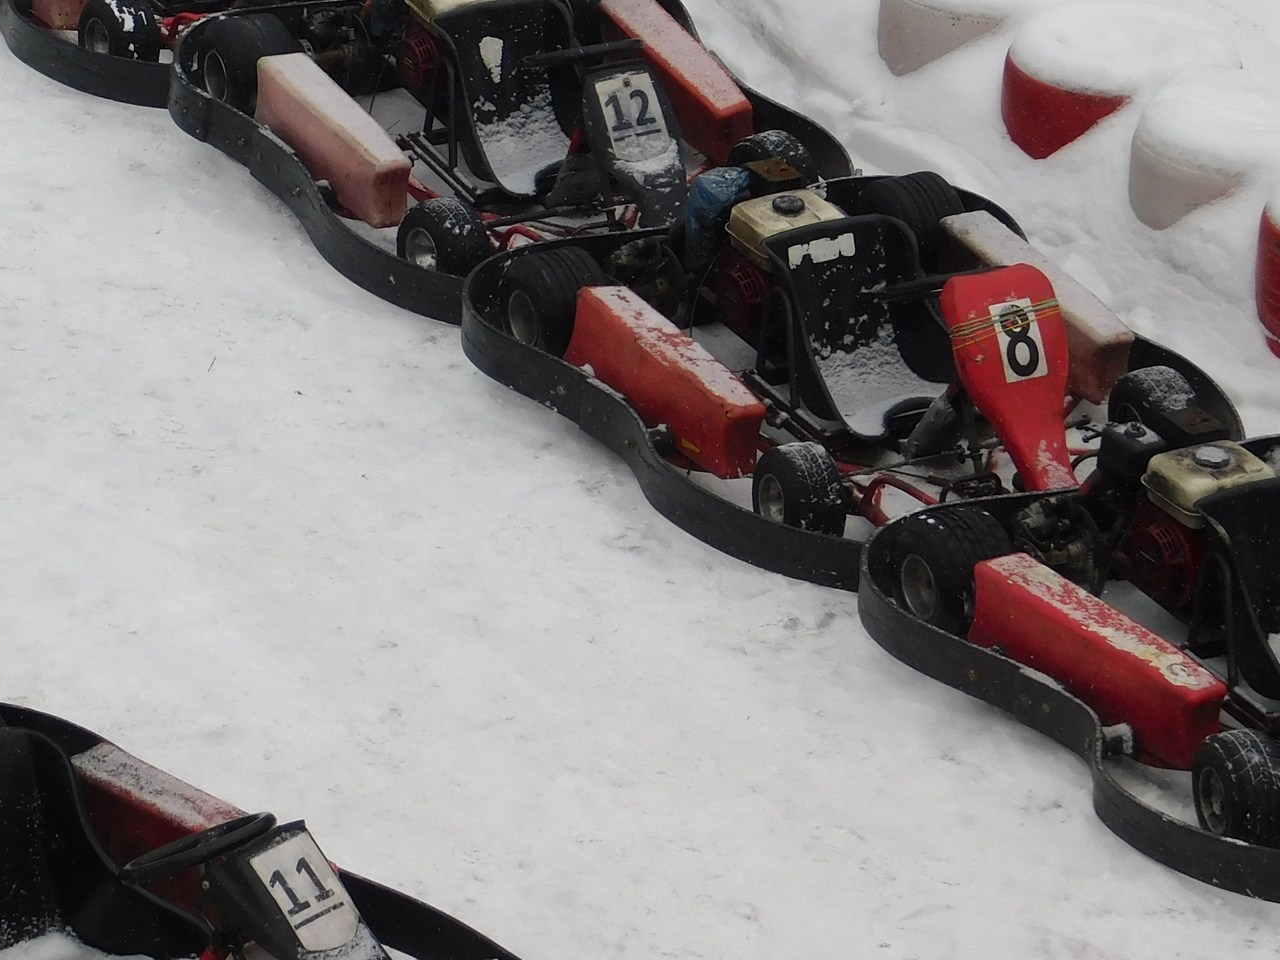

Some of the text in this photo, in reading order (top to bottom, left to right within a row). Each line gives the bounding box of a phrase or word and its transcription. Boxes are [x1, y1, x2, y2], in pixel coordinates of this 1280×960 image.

[604, 88, 658, 132] 12
[998, 303, 1040, 378] 8
[268, 856, 335, 918] 11
